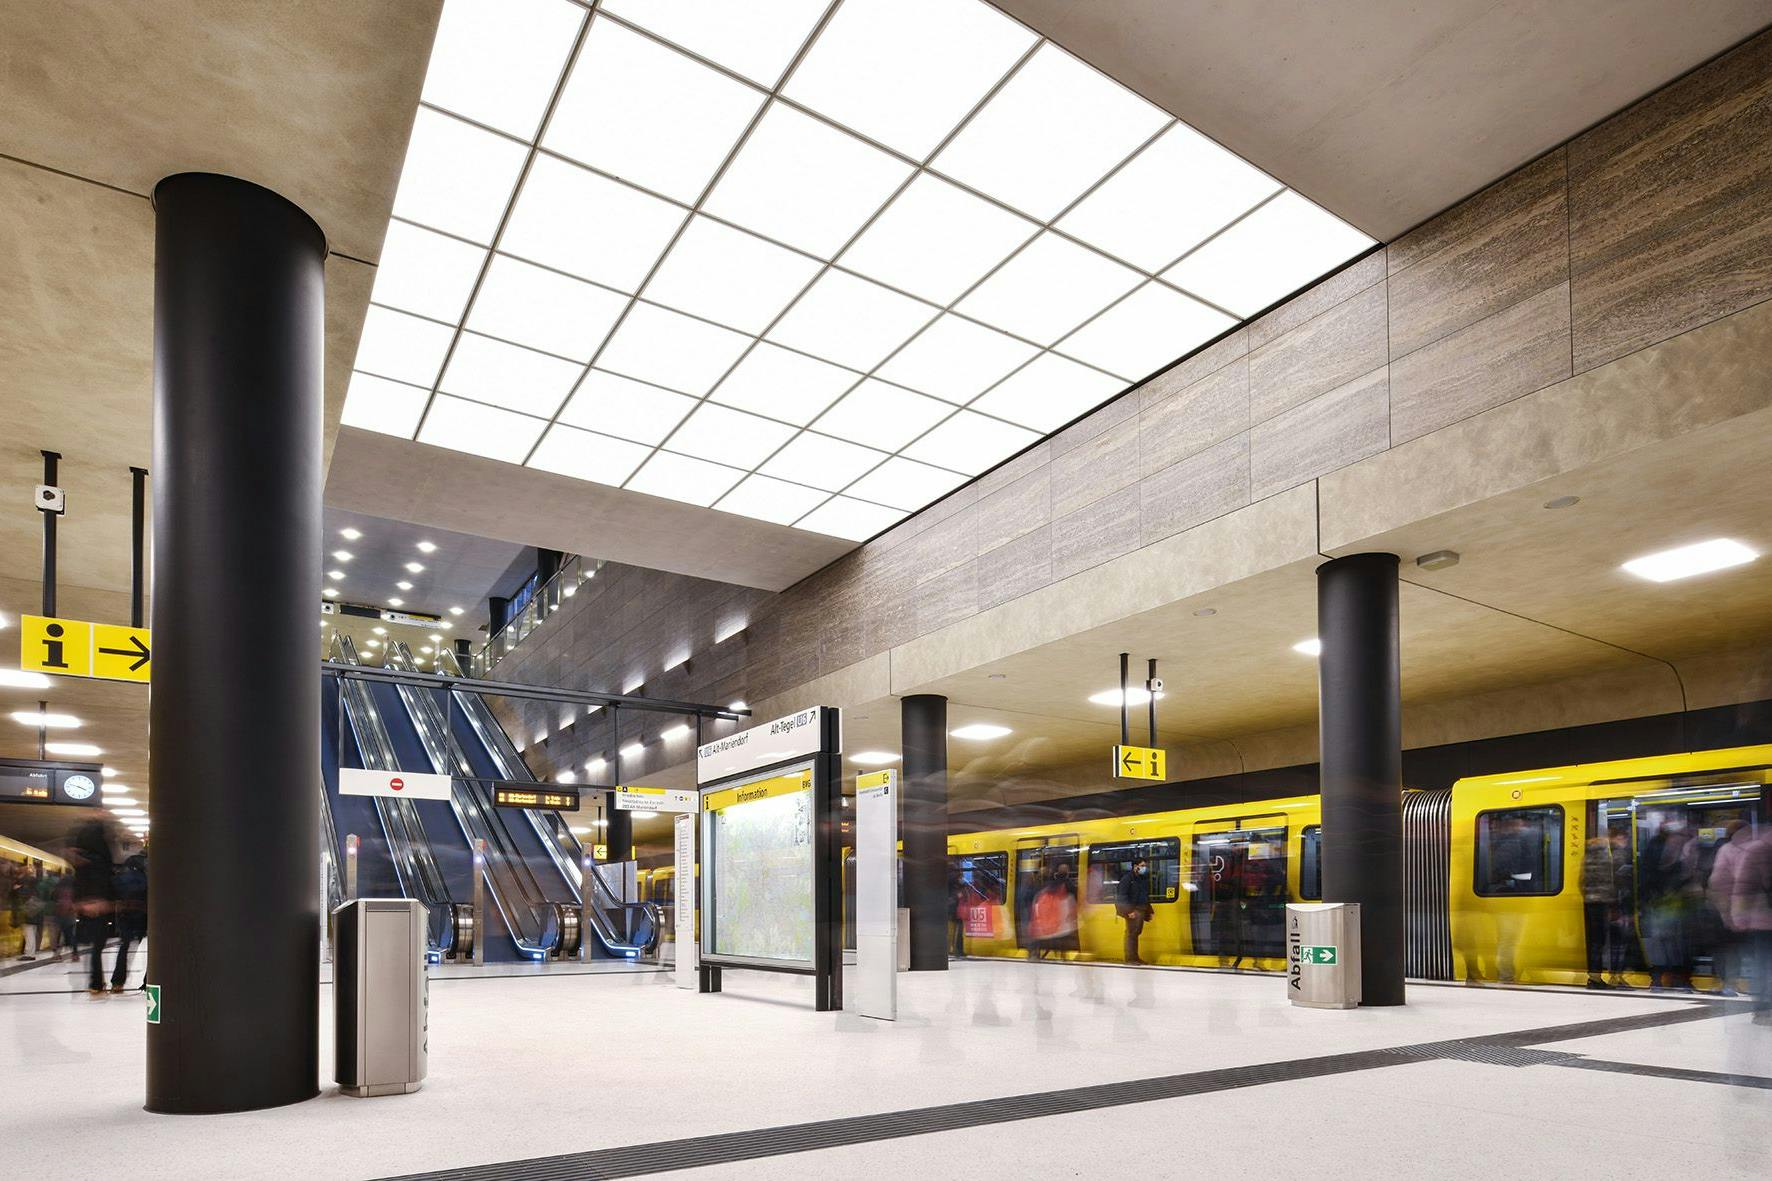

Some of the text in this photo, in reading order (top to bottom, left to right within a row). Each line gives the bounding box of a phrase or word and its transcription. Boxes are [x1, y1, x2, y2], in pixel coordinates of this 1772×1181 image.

[769, 716, 796, 736] Alt-Tegel
[712, 731, 750, 755] Alt-Mariendorf
[736, 787, 768, 803] Information
[971, 908, 986, 921] U5
[1290, 932, 1301, 991] Abfall
